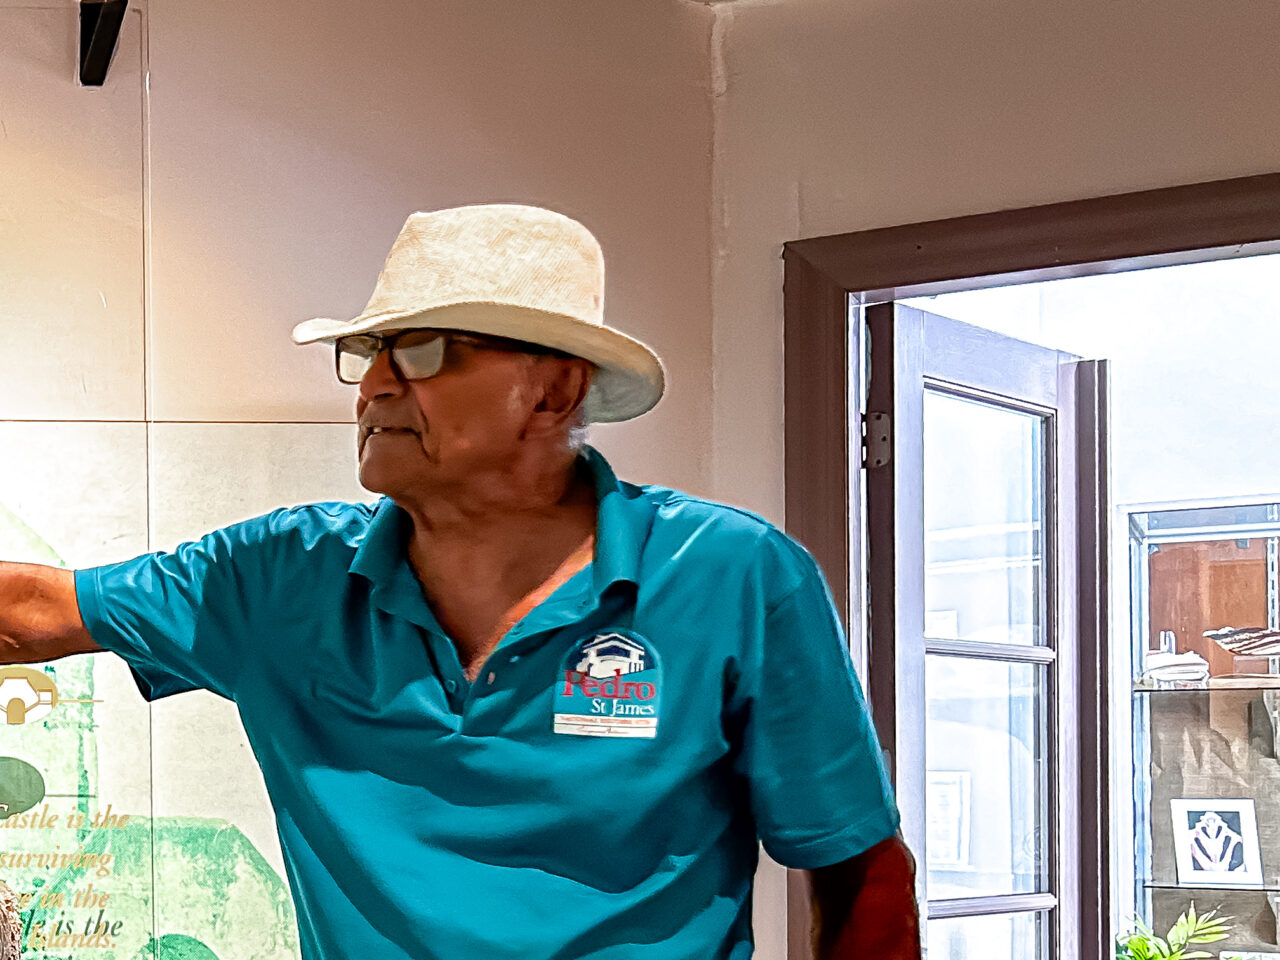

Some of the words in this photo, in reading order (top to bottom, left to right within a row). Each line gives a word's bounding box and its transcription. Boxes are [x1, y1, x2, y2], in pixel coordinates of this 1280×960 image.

[561, 669, 656, 701] Pedro
[591, 698, 607, 713] St
[610, 699, 655, 717] James
[67, 805, 82, 830] is
[93, 804, 131, 830] the
[39, 885, 65, 909] in
[74, 883, 111, 909] the
[26, 922, 117, 948] Islands.
[85, 908, 124, 937] the
